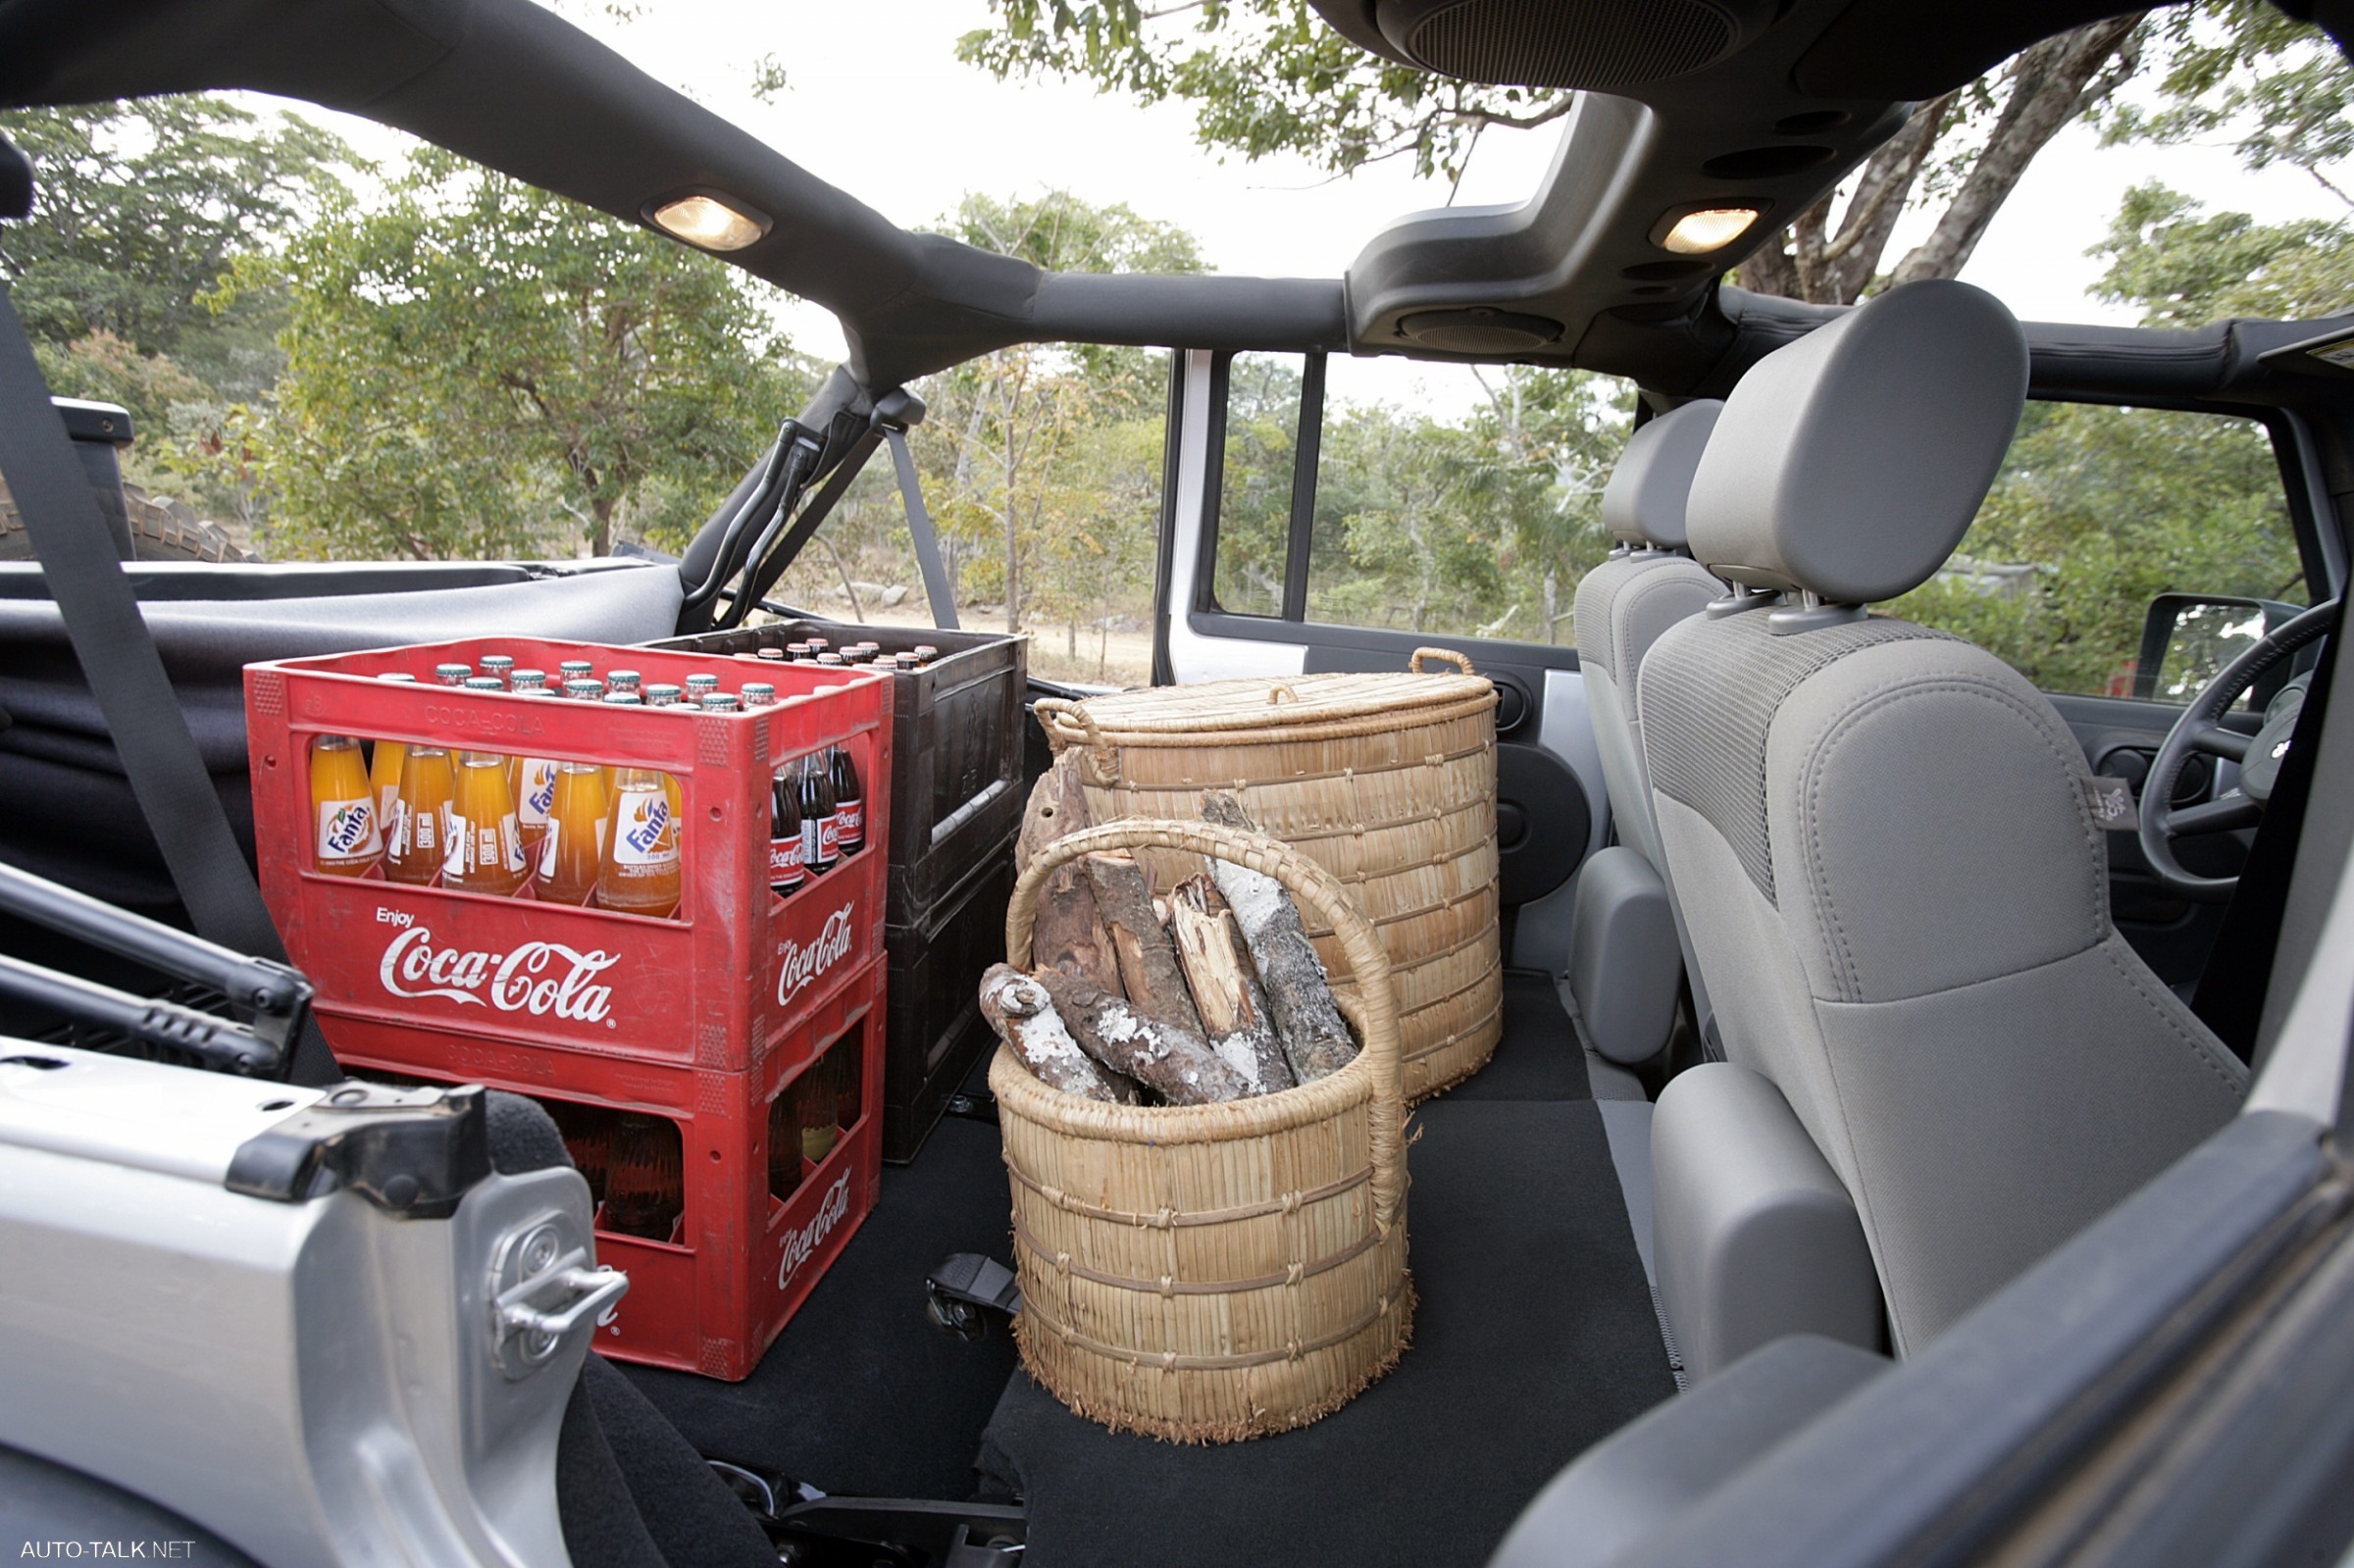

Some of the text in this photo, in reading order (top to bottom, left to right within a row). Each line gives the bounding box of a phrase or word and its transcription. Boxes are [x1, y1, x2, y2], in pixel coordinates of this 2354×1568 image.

[425, 705, 545, 735] COCA-COLA
[328, 806, 368, 853] Fanta
[626, 800, 669, 853] Fanta
[377, 907, 415, 928] Enjoy
[381, 927, 621, 1022] Coca-Cola
[778, 900, 854, 1006] Coca-Cola
[779, 1164, 852, 1290] Coca-Cola
